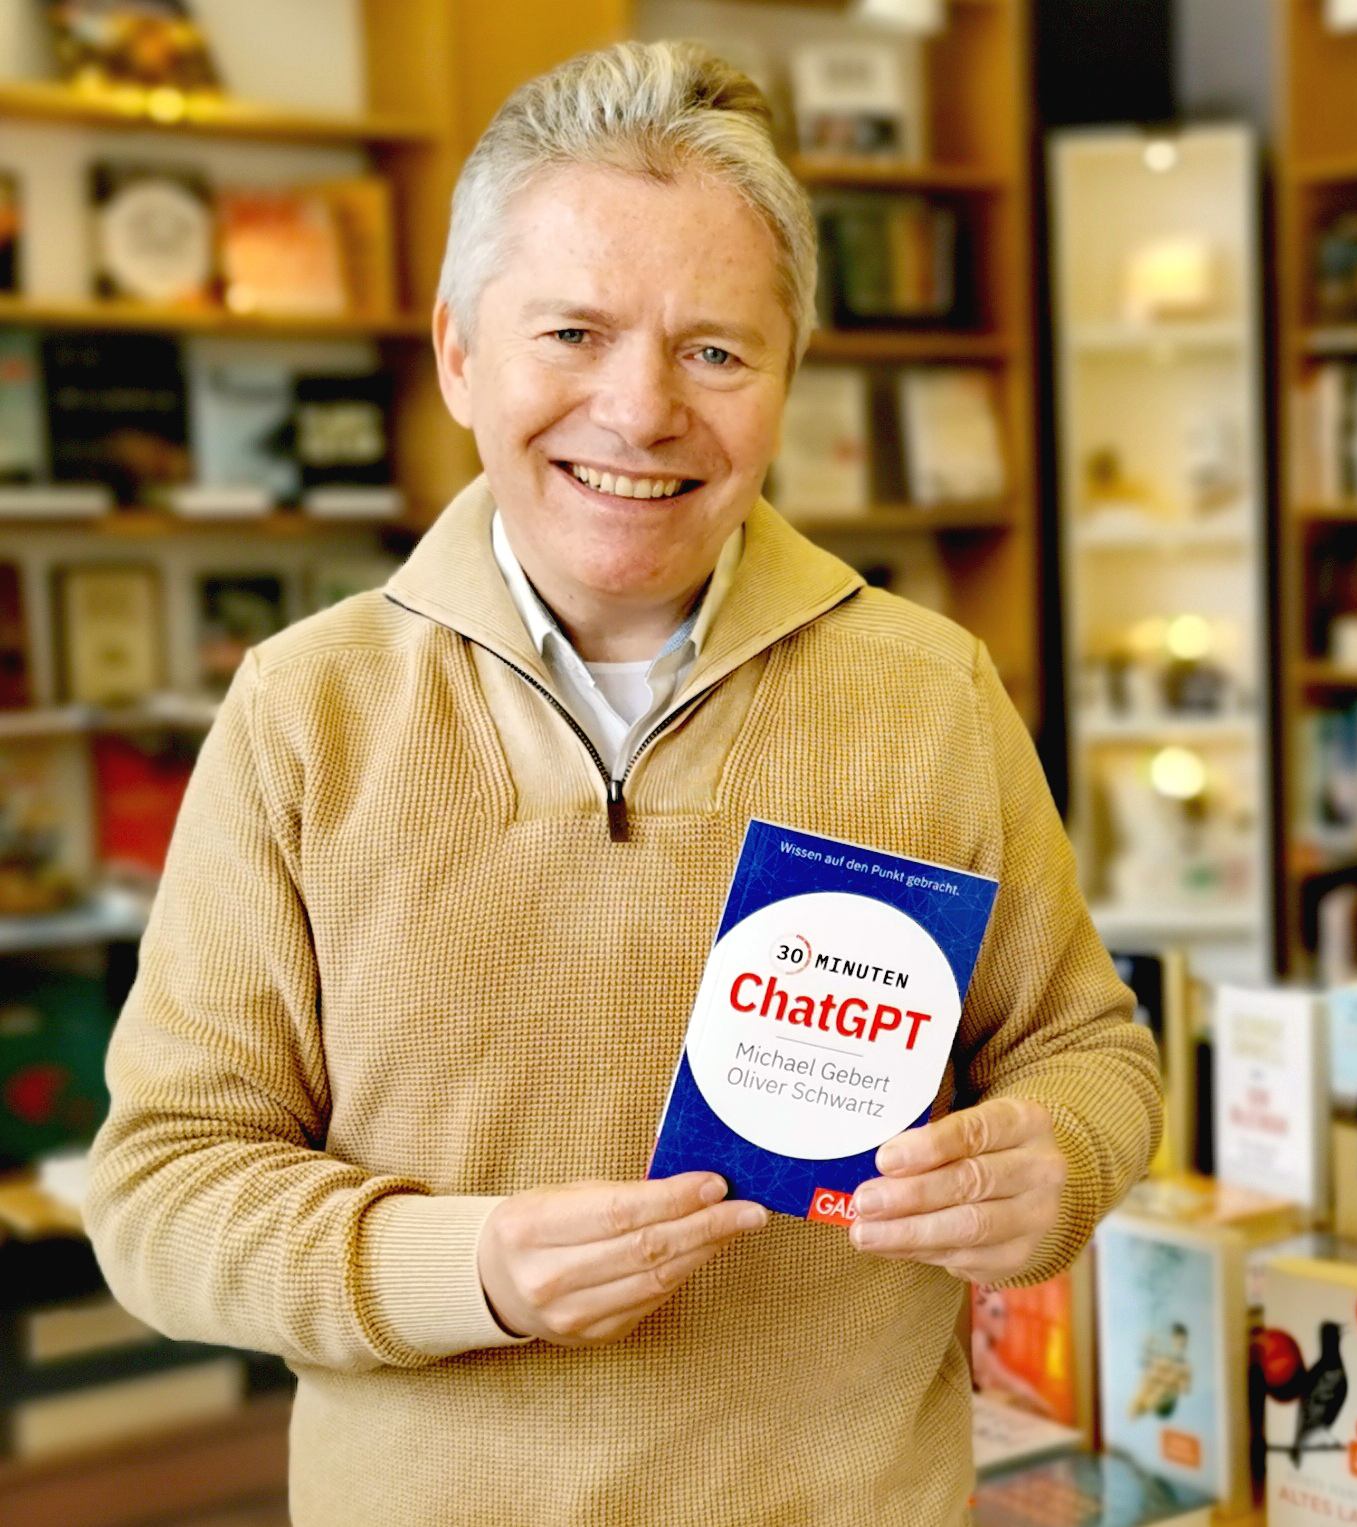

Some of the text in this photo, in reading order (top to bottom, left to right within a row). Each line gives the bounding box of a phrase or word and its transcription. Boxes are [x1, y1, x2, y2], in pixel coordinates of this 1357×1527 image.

[780, 841, 960, 896] Wissen auf den Punkt gebracht.
[776, 944, 909, 989] 30 MINUTEN
[729, 972, 932, 1050] ChatGPT
[727, 1067, 885, 1118] Oliver Schwartz
[735, 1042, 891, 1093] Michael Gebert
[1278, 1484, 1332, 1517] ALTES
